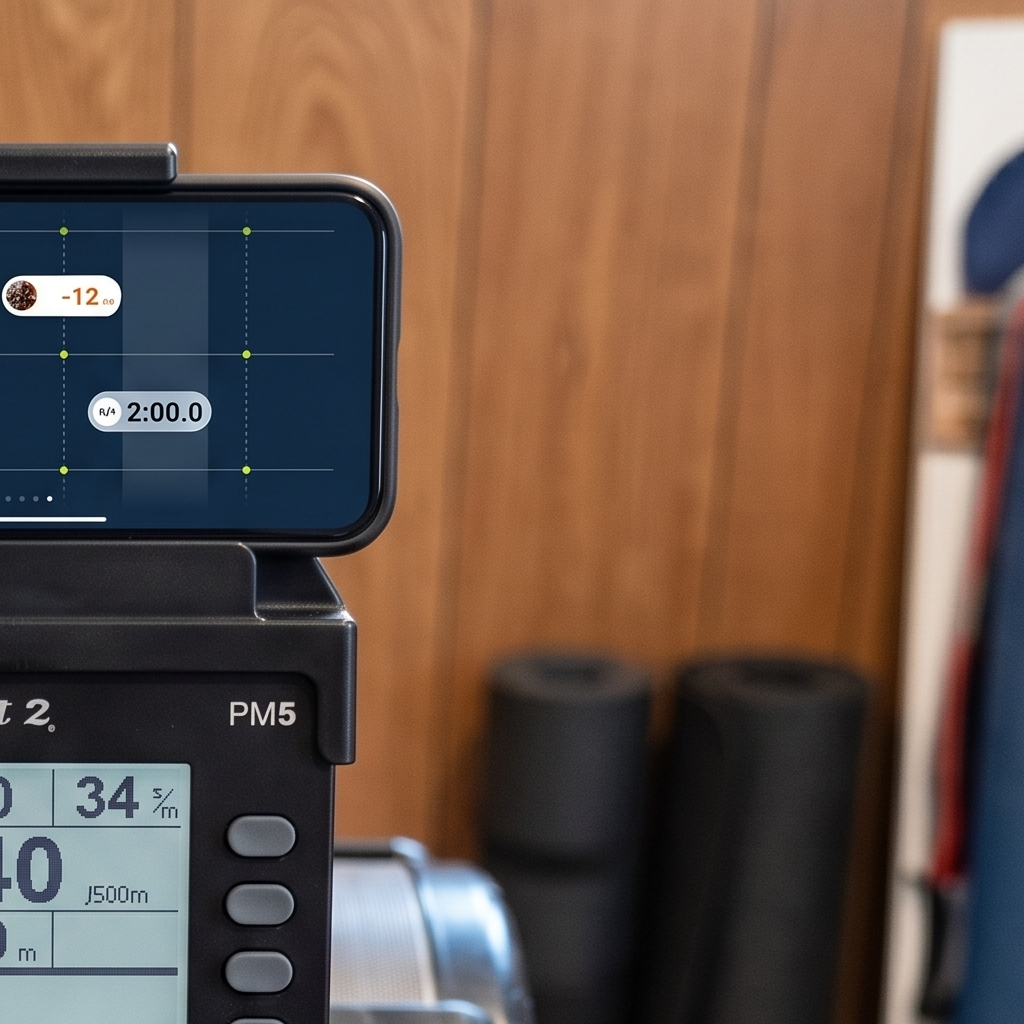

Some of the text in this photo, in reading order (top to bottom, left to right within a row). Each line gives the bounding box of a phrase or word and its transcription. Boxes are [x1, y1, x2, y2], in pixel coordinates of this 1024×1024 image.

[61, 287, 98, 306] -12
[127, 401, 203, 423] 2:00.0
[229, 701, 297, 726] PM5
[76, 775, 140, 819] 34
[18, 947, 37, 962] m
